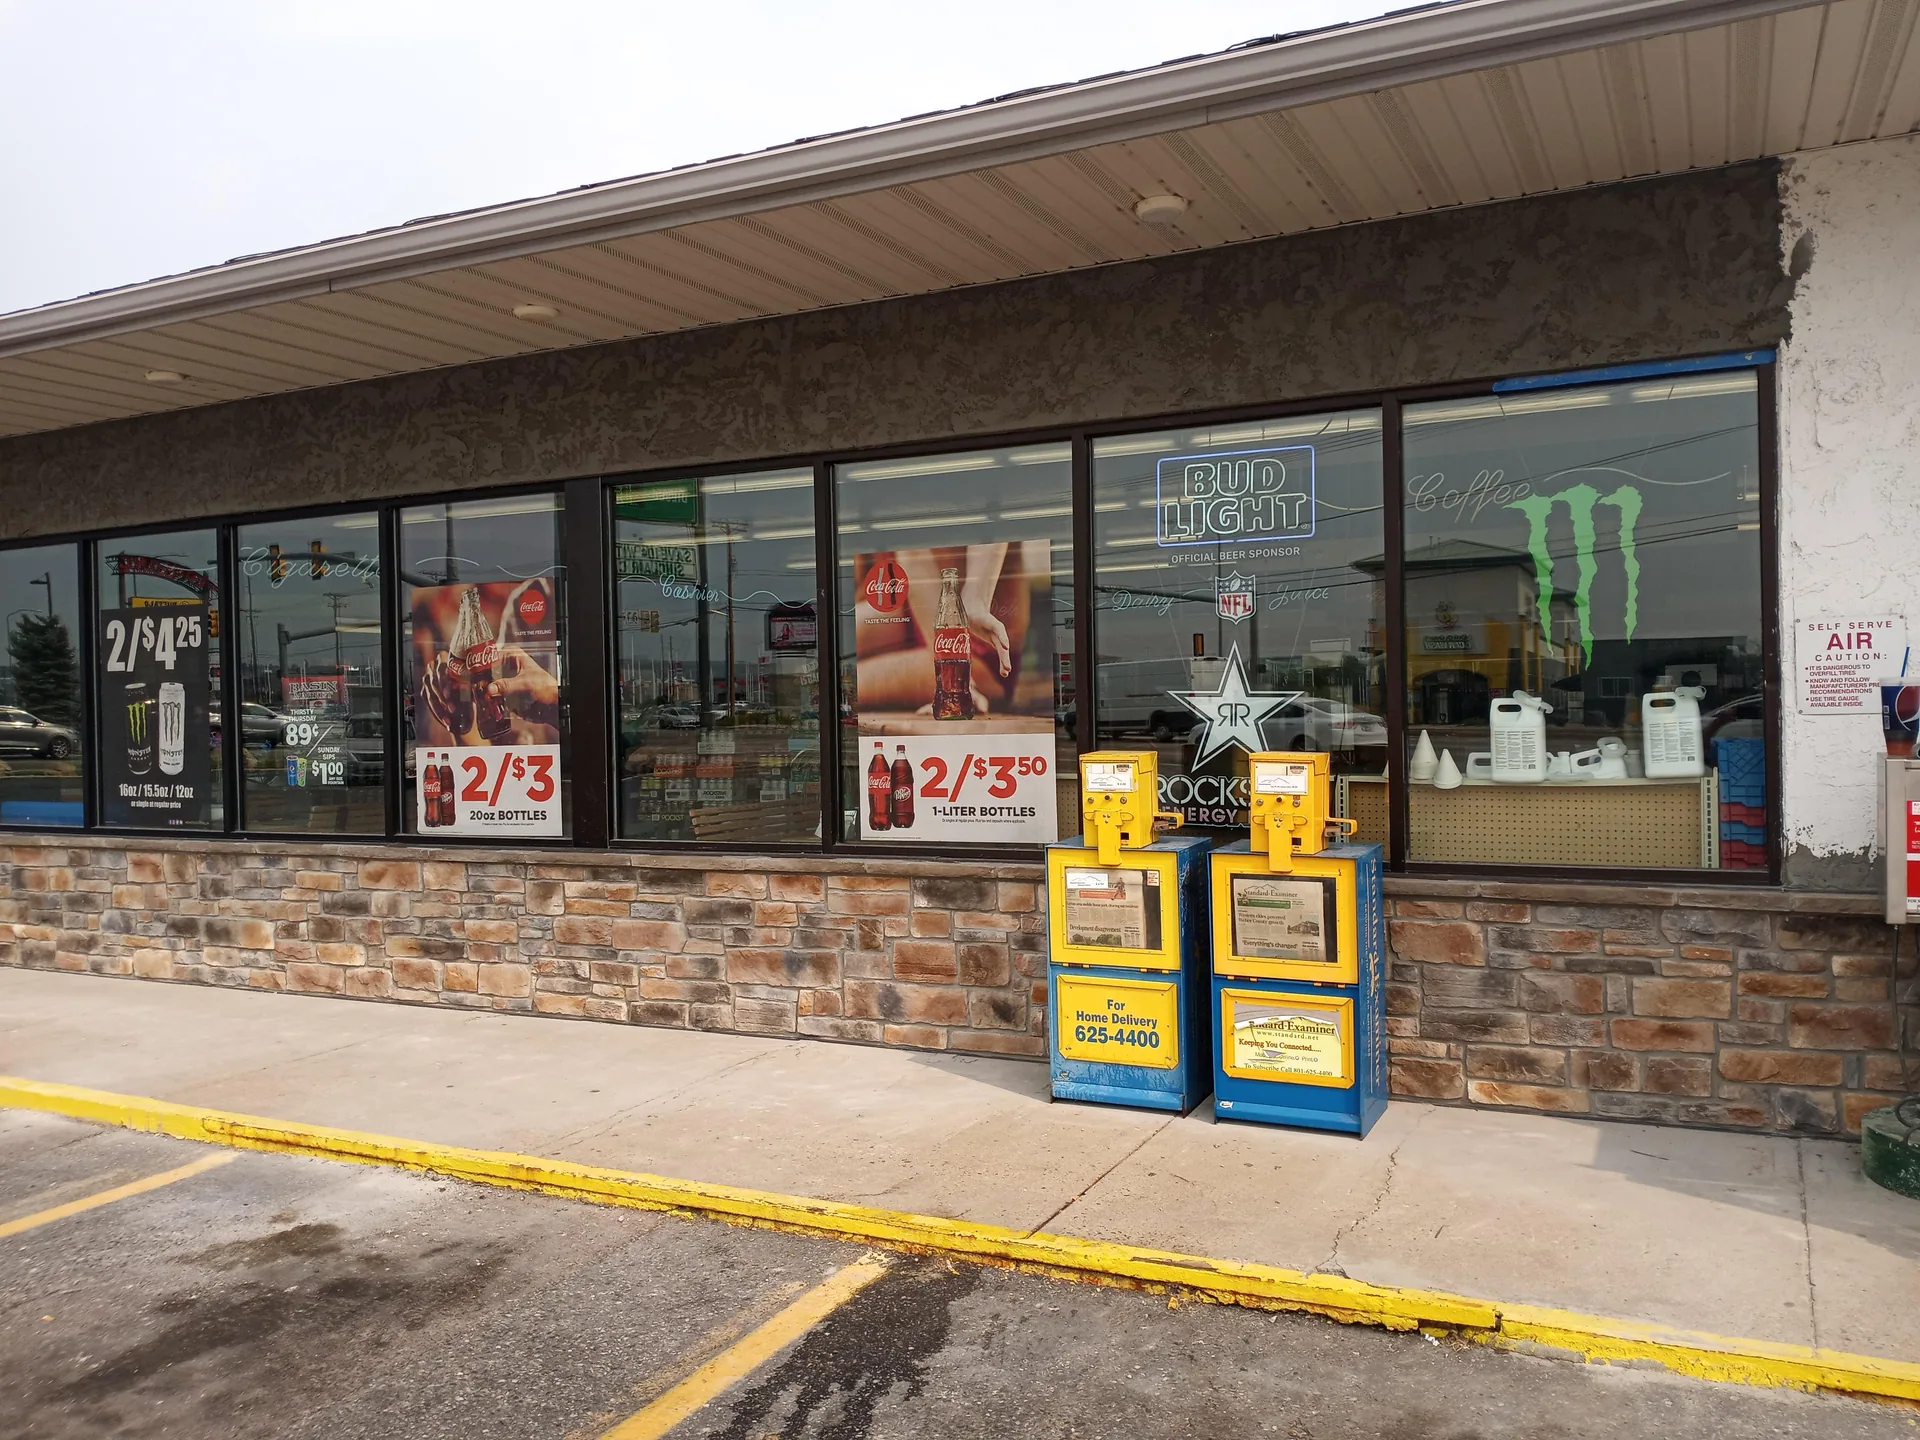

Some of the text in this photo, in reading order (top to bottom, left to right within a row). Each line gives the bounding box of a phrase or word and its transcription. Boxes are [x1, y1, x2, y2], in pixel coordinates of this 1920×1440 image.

[1184, 458, 1286, 498] BUD
[1407, 469, 1531, 523] Coffee
[1164, 492, 1307, 538] LIGHT
[1171, 546, 1301, 565] OFFICIAL BEER SPONSOR
[659, 572, 720, 602] Cashier
[866, 577, 907, 595] Coca-Cola
[1112, 589, 1175, 616] Dairy
[1220, 592, 1252, 617] NFL
[1808, 620, 1893, 631] SELF SERVE
[1826, 632, 1873, 651] AIR
[1815, 652, 1888, 662] CAUTION:
[285, 723, 320, 746] 89¢
[118, 783, 137, 797] 16oz
[143, 783, 169, 798] 15.5oz
[175, 784, 194, 799] 12oz
[1157, 776, 1251, 807] ROCKS
[469, 810, 547, 821] 20oz BOTTLES
[932, 805, 1036, 818] 1-LITER BOTTLES
[1107, 998, 1126, 1011] For
[1076, 1010, 1158, 1029] Home Delivery
[1075, 1024, 1160, 1049] 625-4400
[1238, 1038, 1265, 1049] Keeping
[1265, 1040, 1278, 1049] You
[1256, 1030, 1319, 1041] www.standard.net
[1253, 1063, 1280, 1072] Subscribe
[1280, 1065, 1293, 1073] Call
